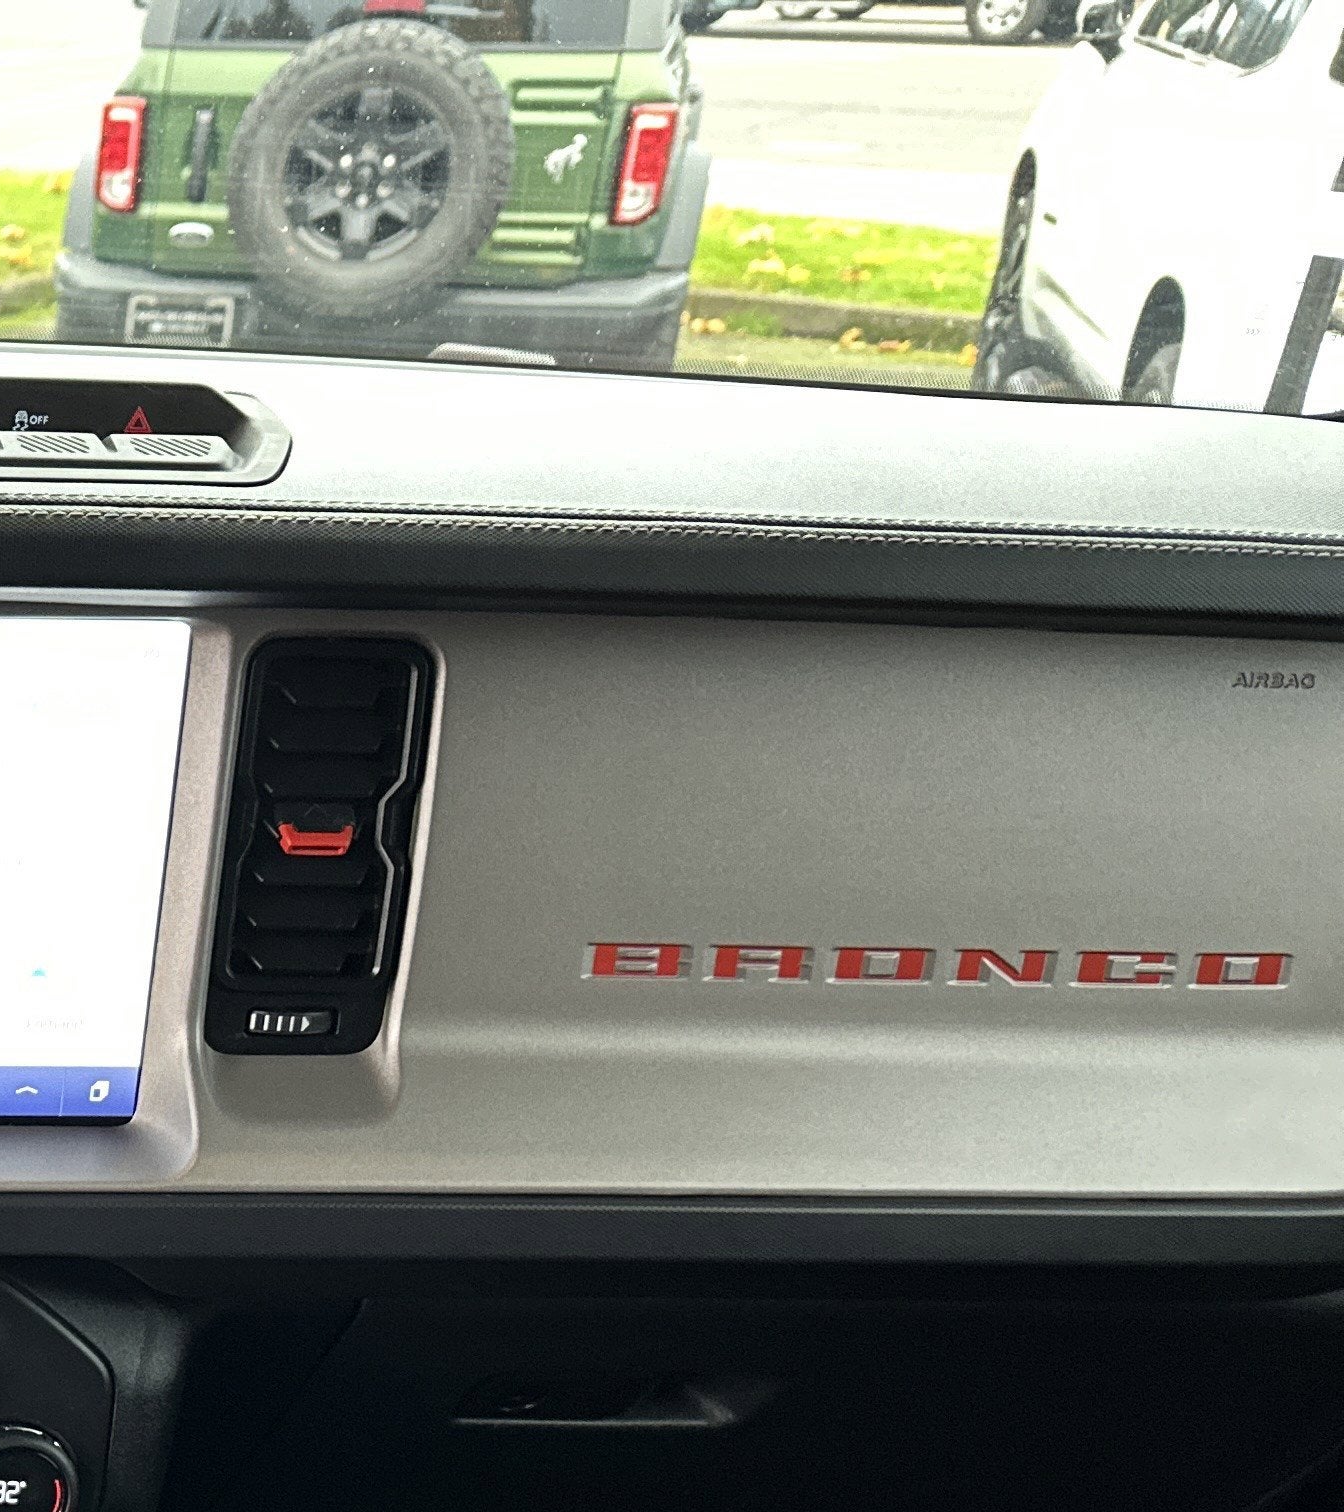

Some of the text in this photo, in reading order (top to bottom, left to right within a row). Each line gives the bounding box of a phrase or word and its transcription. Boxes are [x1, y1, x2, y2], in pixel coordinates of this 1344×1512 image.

[29, 415, 49, 425] OFF
[1231, 672, 1316, 689] AIRBAG
[581, 942, 1294, 992] BRONCO
